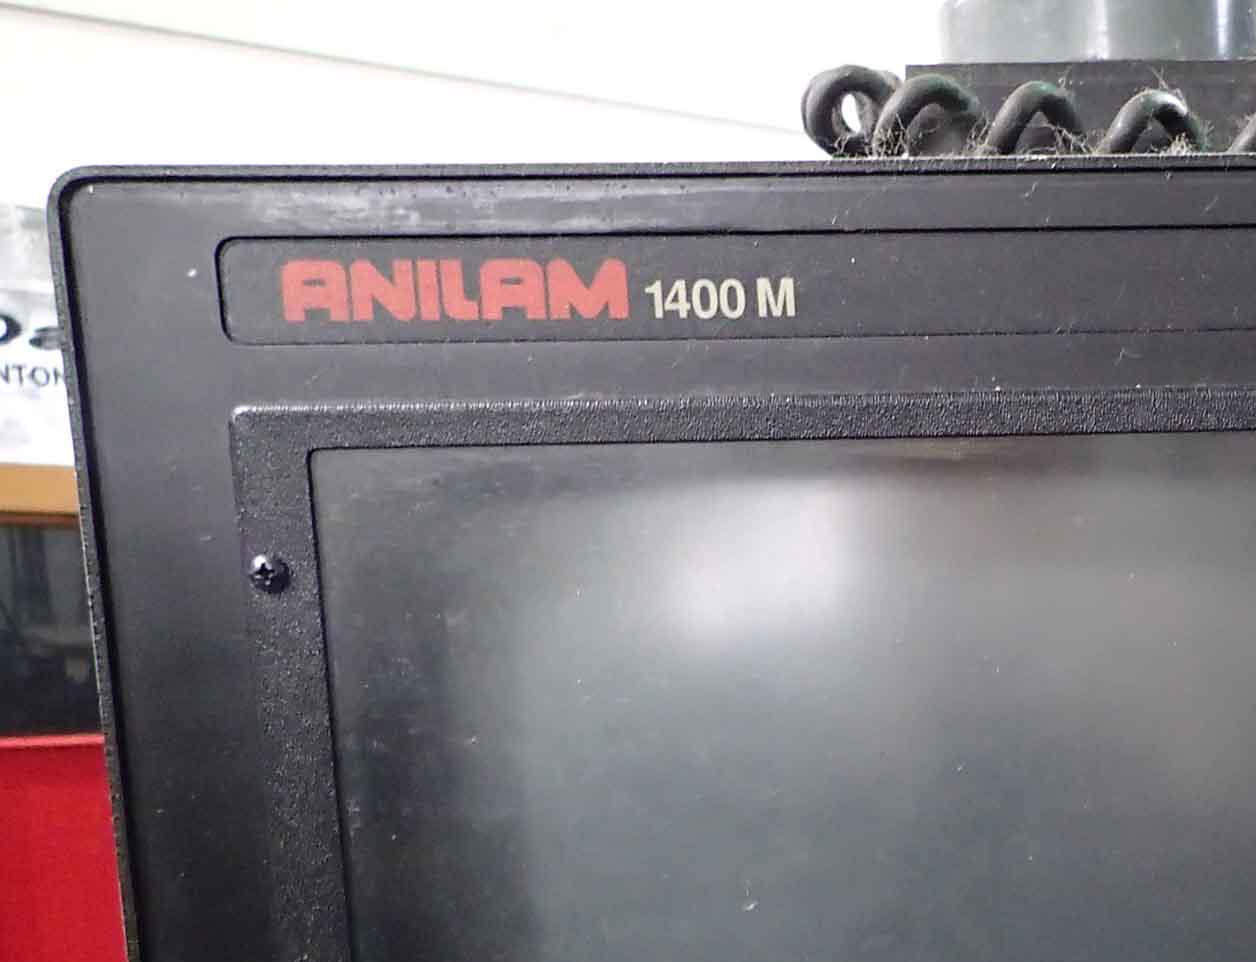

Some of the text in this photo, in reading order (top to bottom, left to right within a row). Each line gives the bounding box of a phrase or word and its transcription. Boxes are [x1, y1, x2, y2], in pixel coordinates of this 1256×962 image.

[281, 257, 797, 321] ANILAM 1400 M
